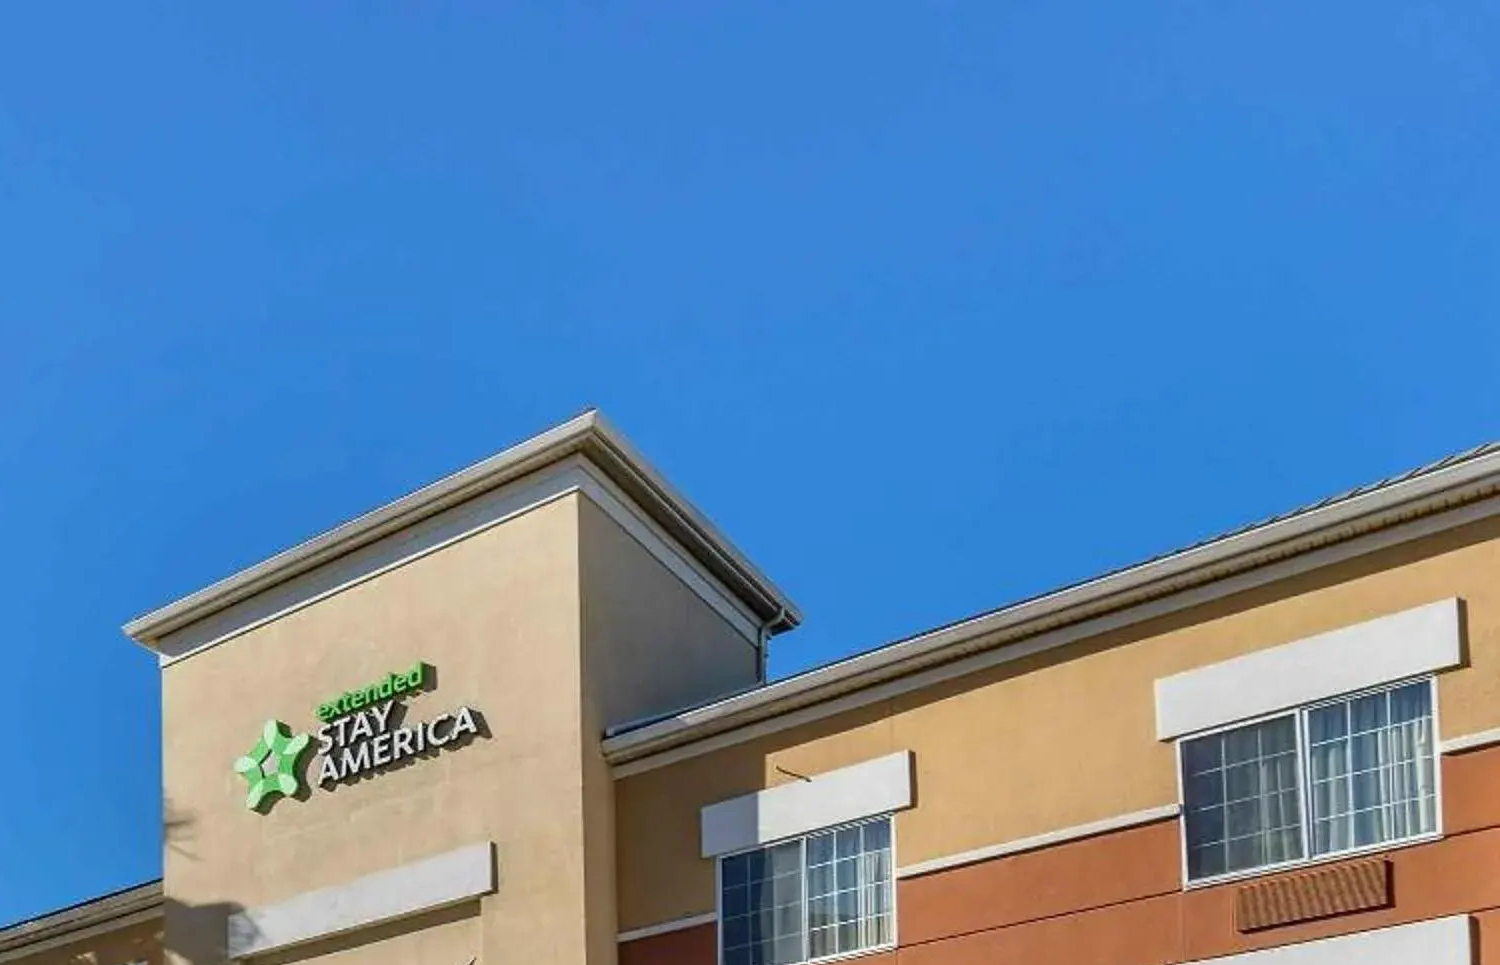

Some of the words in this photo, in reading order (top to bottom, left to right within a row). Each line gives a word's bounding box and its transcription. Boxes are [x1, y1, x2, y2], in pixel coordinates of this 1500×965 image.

[316, 662, 424, 721] extended
[318, 700, 395, 755] STAY
[318, 706, 477, 785] AMERICA
